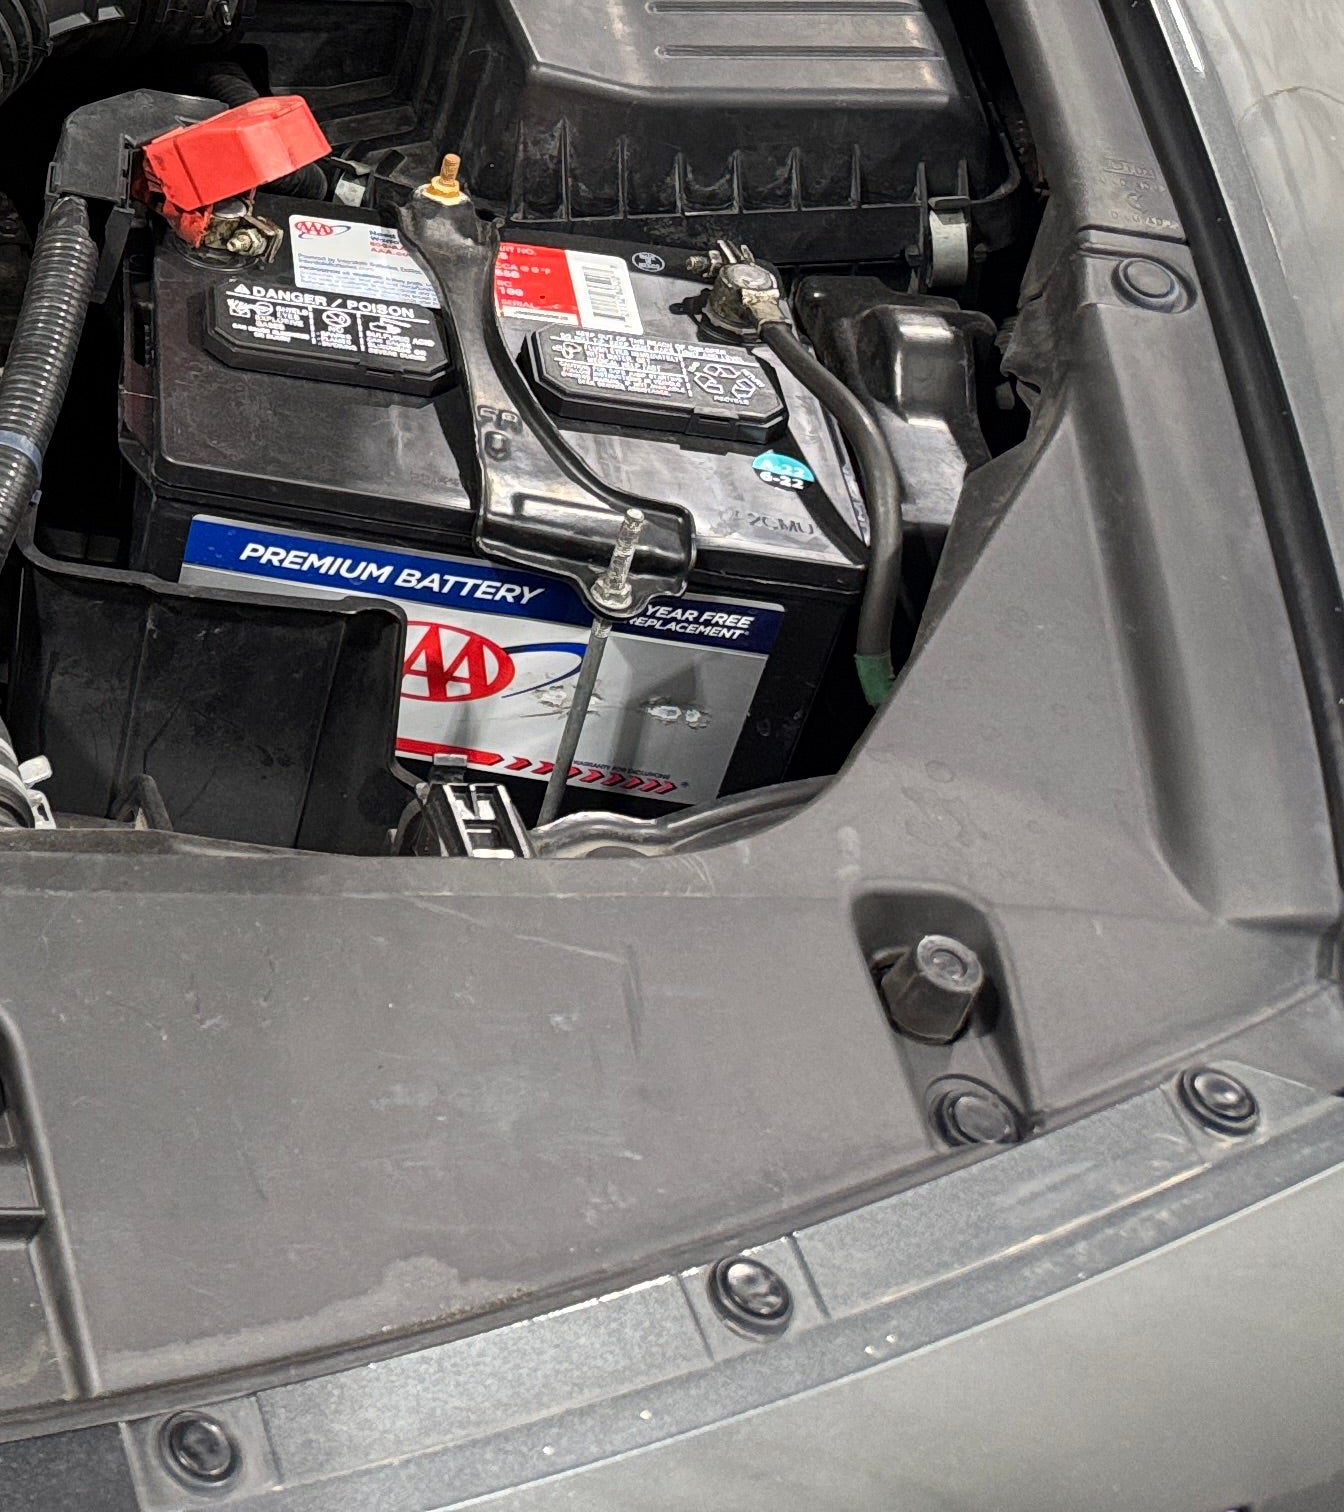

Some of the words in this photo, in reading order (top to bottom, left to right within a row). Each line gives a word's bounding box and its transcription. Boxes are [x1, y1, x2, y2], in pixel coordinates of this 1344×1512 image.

[253, 287, 327, 307] DANGER
[347, 300, 414, 318] POISON
[239, 543, 393, 584] PREMIUM
[395, 568, 546, 605] BATTERY
[646, 604, 698, 623] YEAR
[699, 610, 755, 629] FREE
